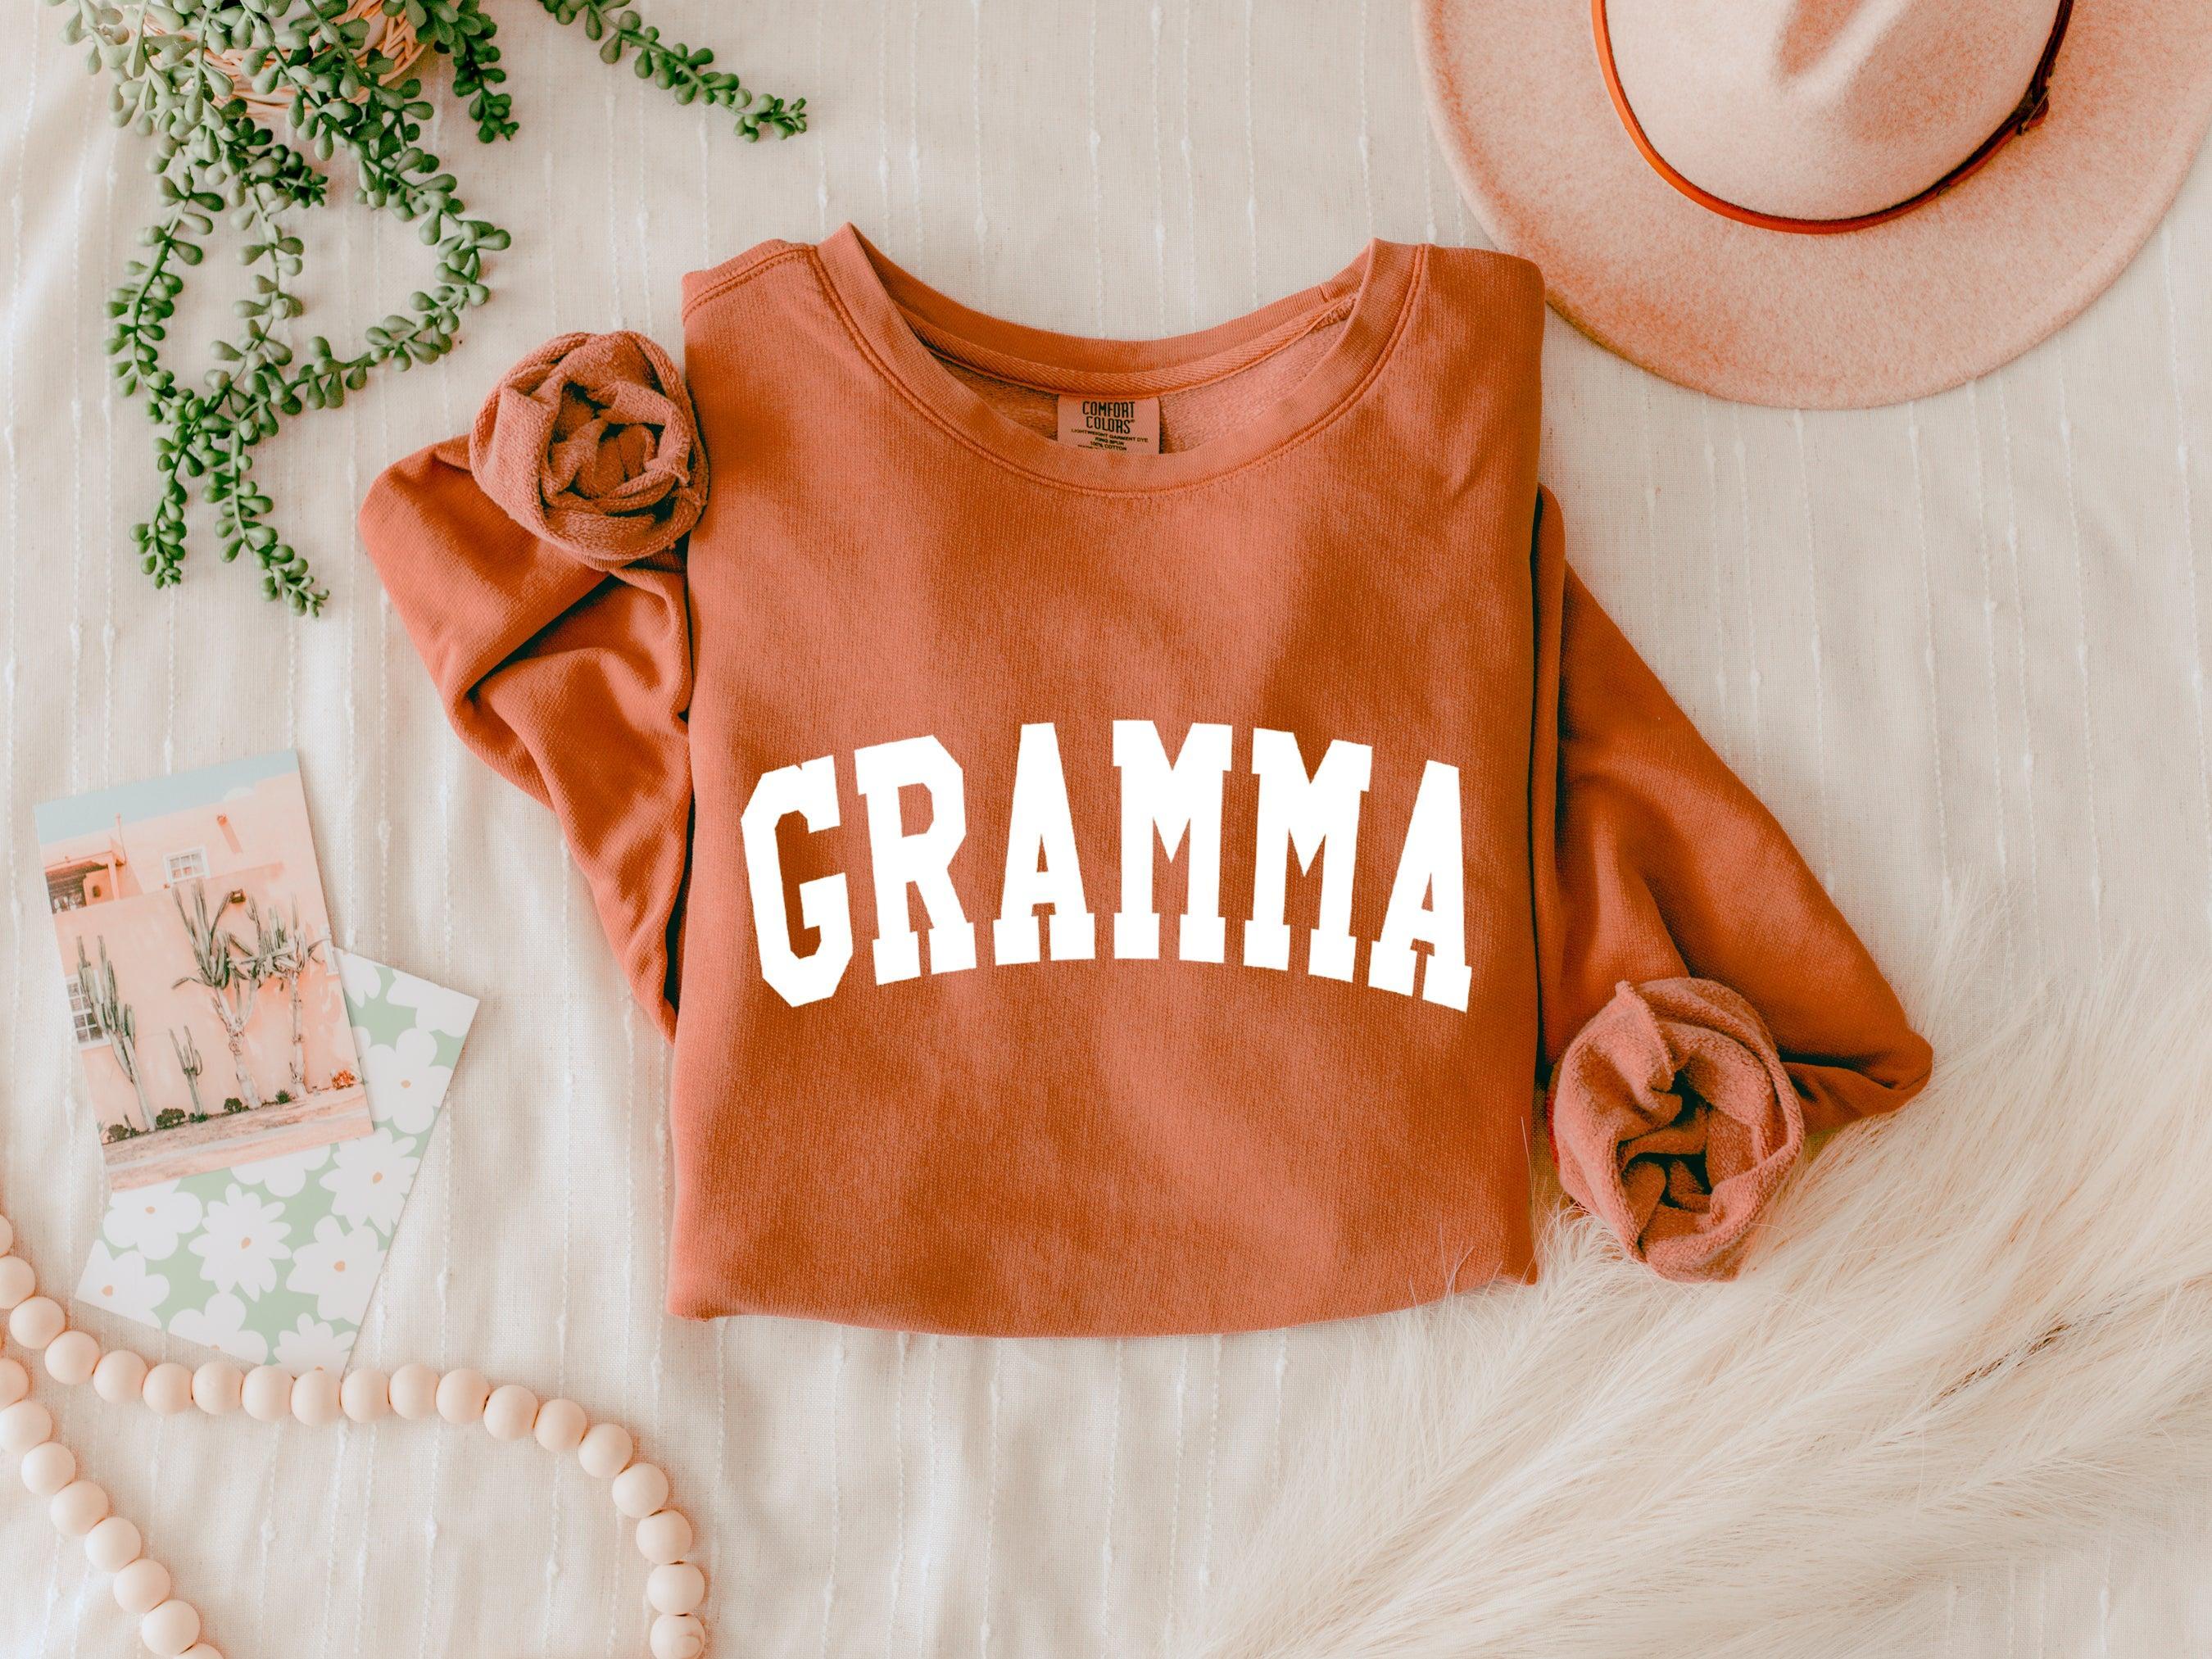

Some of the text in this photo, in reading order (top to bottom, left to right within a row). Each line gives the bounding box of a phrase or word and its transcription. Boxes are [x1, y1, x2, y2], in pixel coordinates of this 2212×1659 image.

[1082, 401, 1135, 418] COMFORT
[1072, 428, 1108, 437] LIGHTWEIGHT
[741, 720, 1471, 1012] GRAMMA
